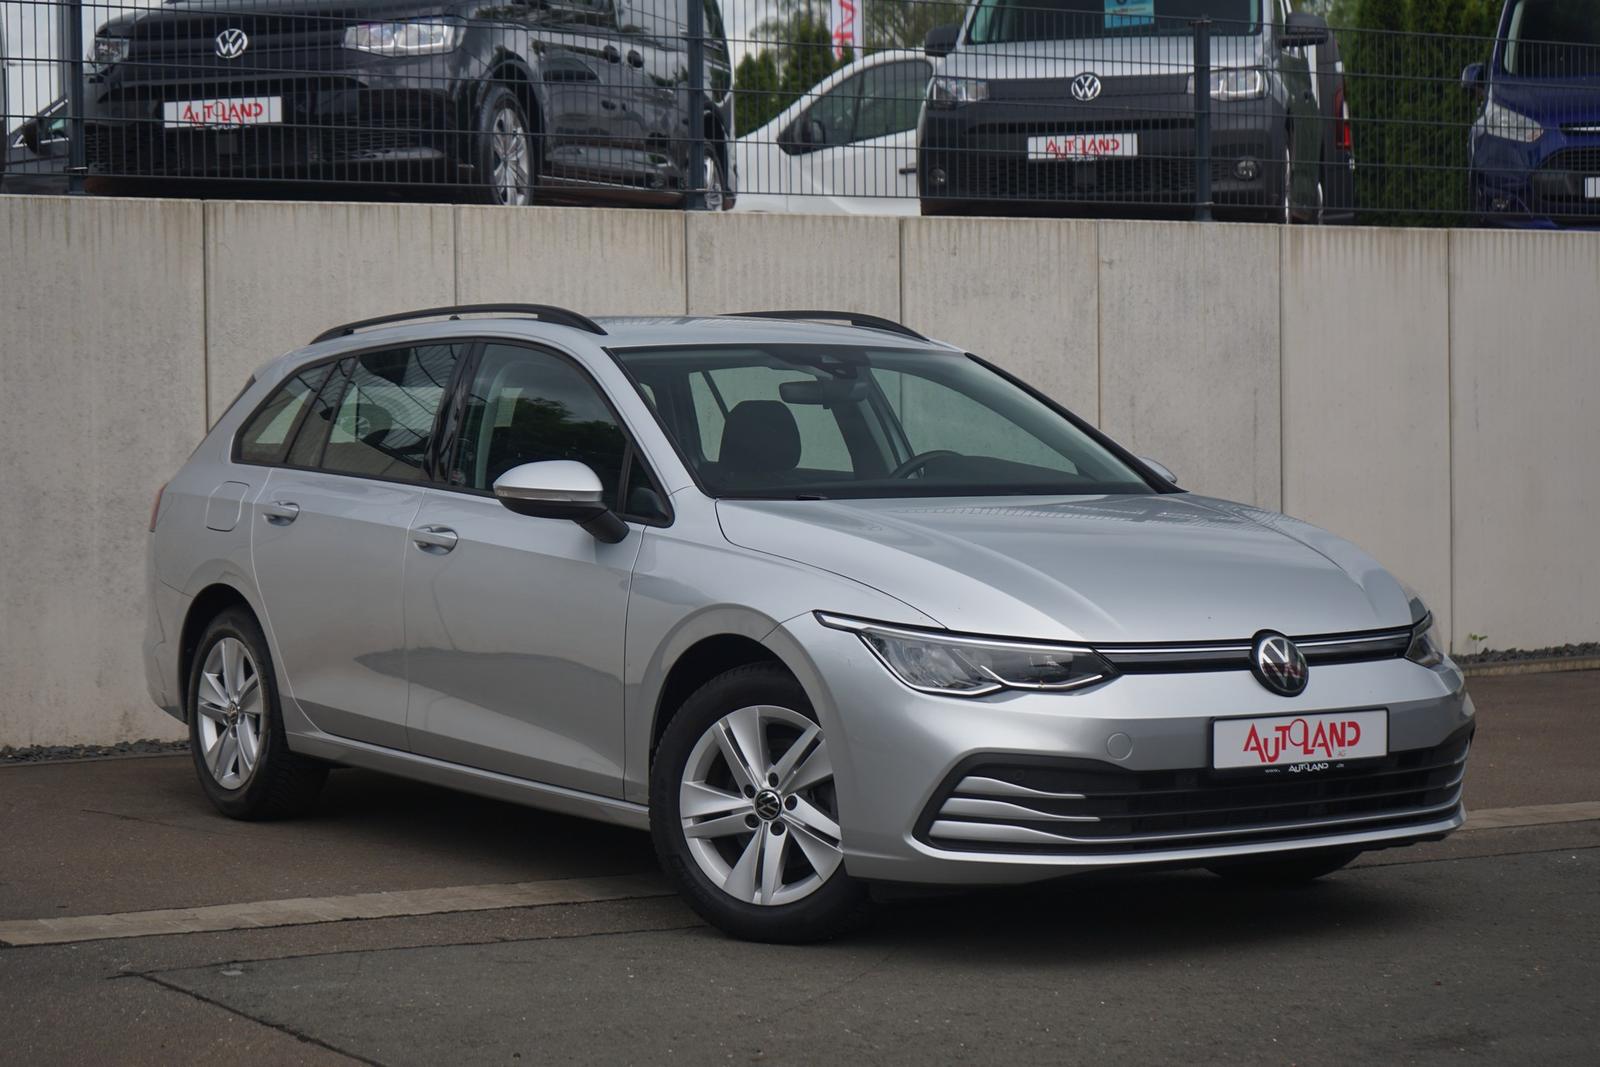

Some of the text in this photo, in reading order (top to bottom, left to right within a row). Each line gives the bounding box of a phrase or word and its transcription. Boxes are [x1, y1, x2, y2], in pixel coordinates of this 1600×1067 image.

[216, 29, 248, 58] VW
[1071, 74, 1101, 101] VW
[1258, 635, 1308, 692] VW
[1243, 718, 1361, 763] AUTOLAND
